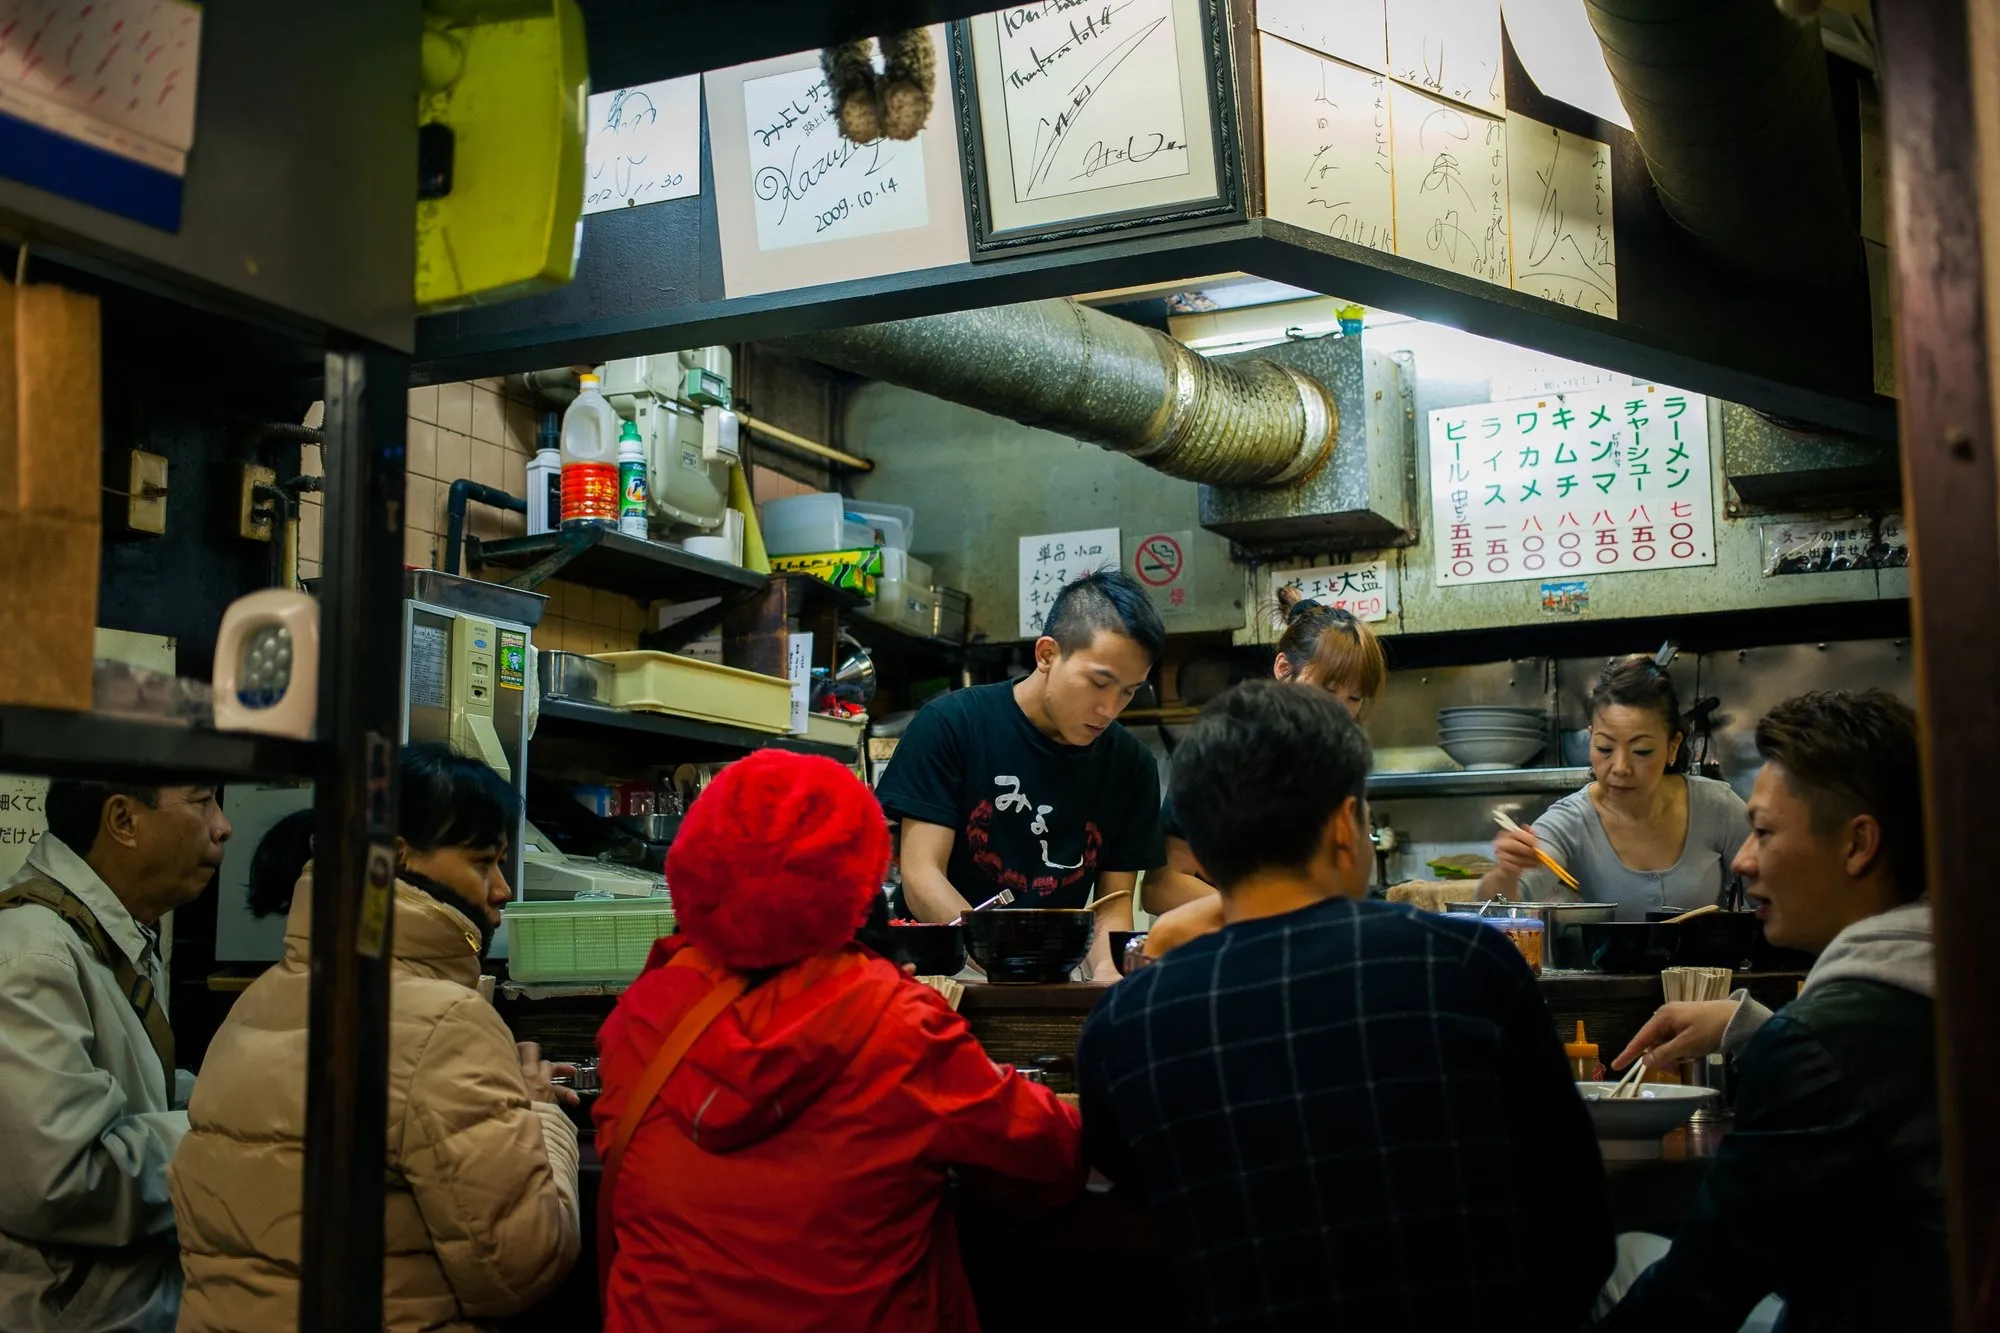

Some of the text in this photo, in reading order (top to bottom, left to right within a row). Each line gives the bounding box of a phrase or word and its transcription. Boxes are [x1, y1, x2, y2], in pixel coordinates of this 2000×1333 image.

[661, 174, 683, 188] 30
[1447, 420, 1470, 483] ビール
[1482, 418, 1506, 506] ライス
[1517, 412, 1542, 502] ワカメ
[1552, 407, 1578, 498] キムチ
[1589, 405, 1616, 494] メンマ
[1624, 399, 1652, 491] チャーシュー
[1664, 396, 1689, 488] ラーメン
[1030, 569, 1067, 585] メンマ
[1036, 543, 1066, 565] 単品
[1782, 526, 1899, 544] スープの継ぎ足は
[1029, 589, 1057, 606] キム
[994, 775, 1084, 869] みよし
